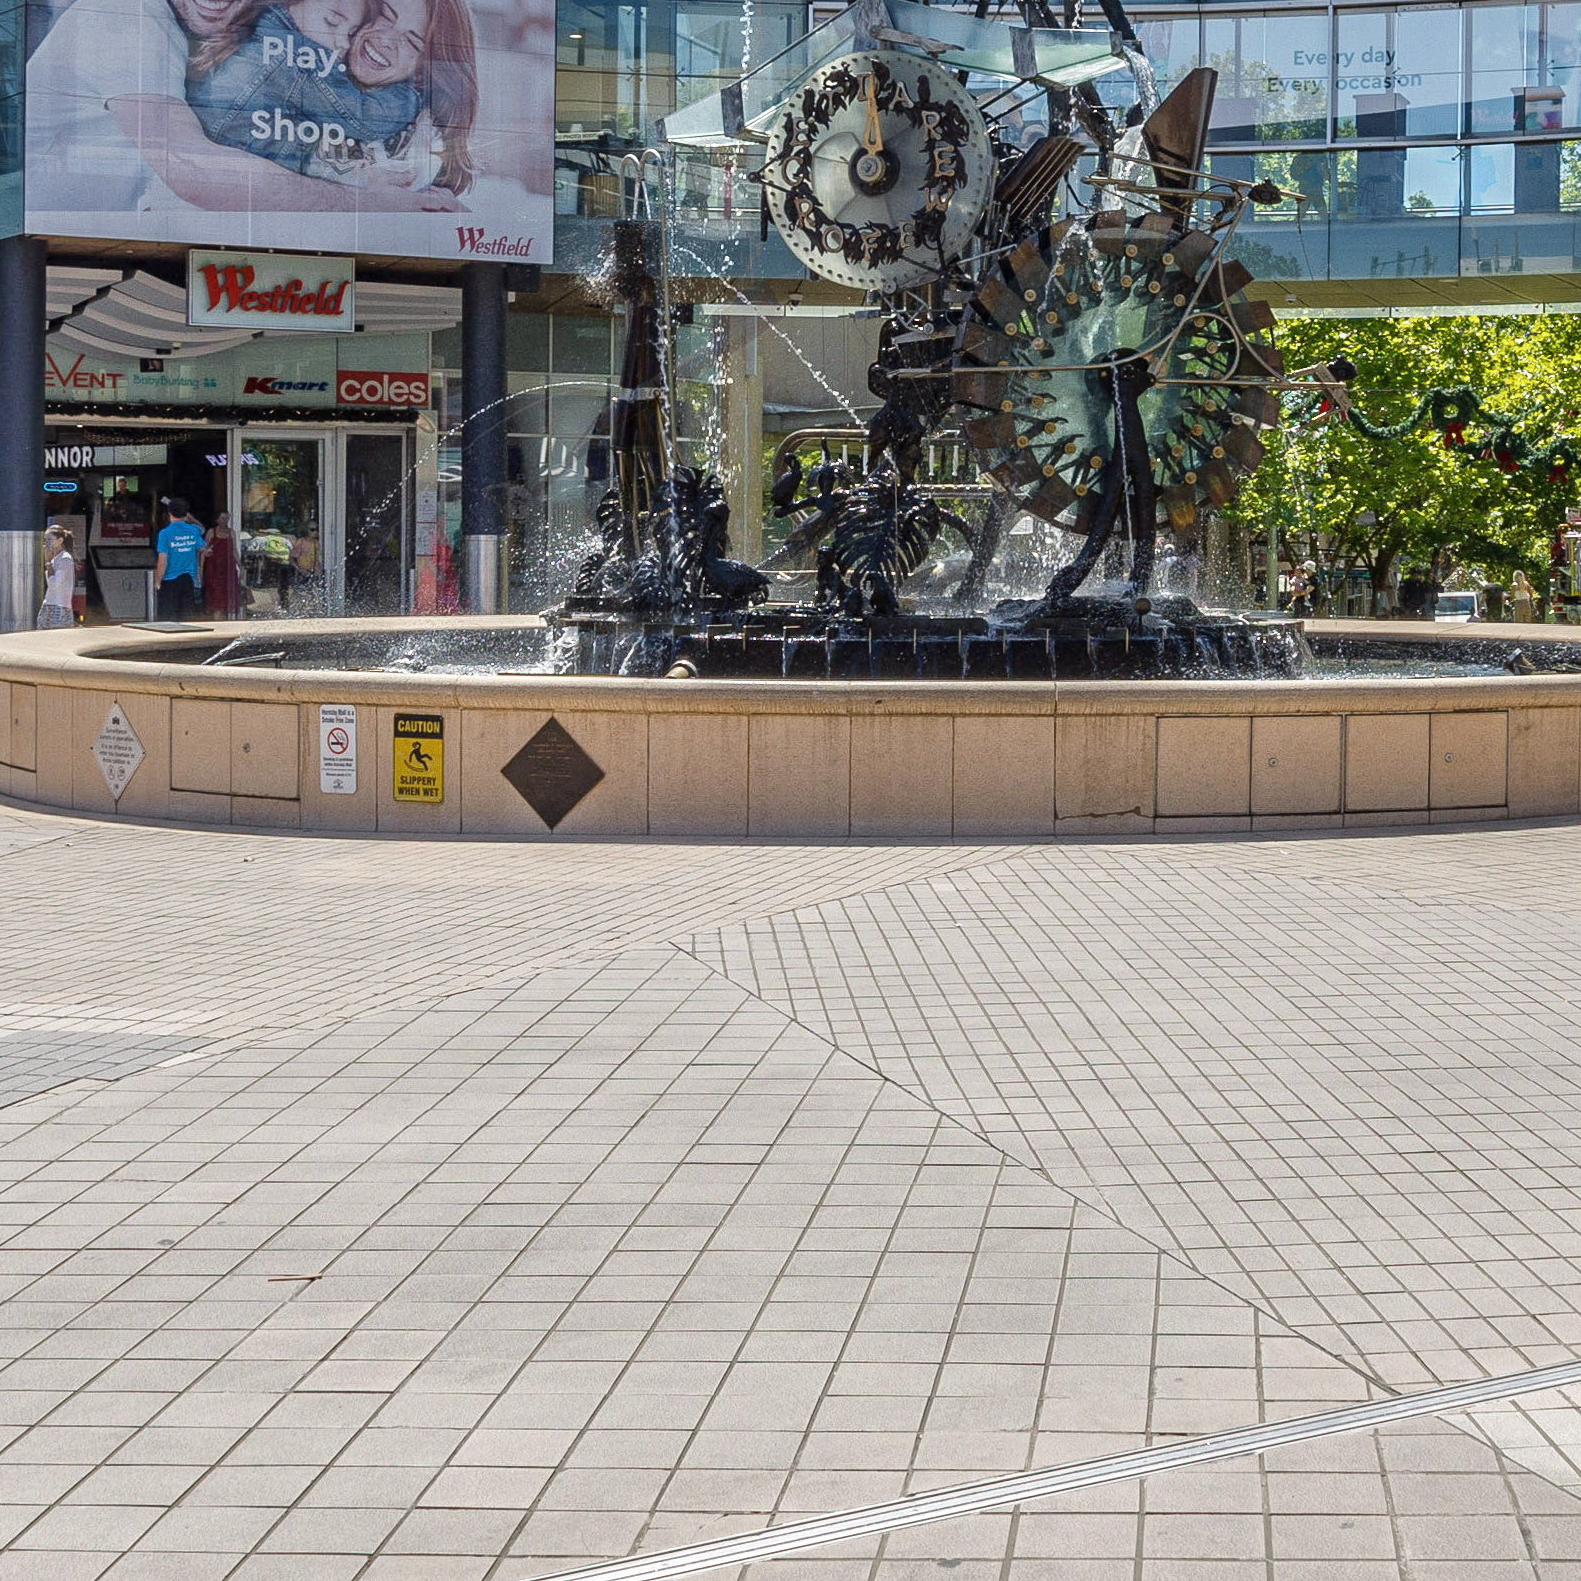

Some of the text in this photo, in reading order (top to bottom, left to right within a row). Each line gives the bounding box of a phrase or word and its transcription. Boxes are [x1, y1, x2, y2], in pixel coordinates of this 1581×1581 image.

[263, 36, 346, 76] Play.
[1293, 46, 1396, 68] Every day
[1267, 74, 1422, 95] Every occasion
[251, 109, 354, 150] Shop.
[455, 225, 533, 258] Westfield
[198, 263, 347, 317] Westfield
[45, 352, 123, 389] EVENT
[243, 377, 329, 395] Kmart
[340, 374, 427, 404] coles
[44, 445, 94, 469] NNOR
[398, 720, 440, 733] CAUTION
[398, 787, 439, 797] WHEN WET
[400, 776, 436, 786] SLIPPERY
